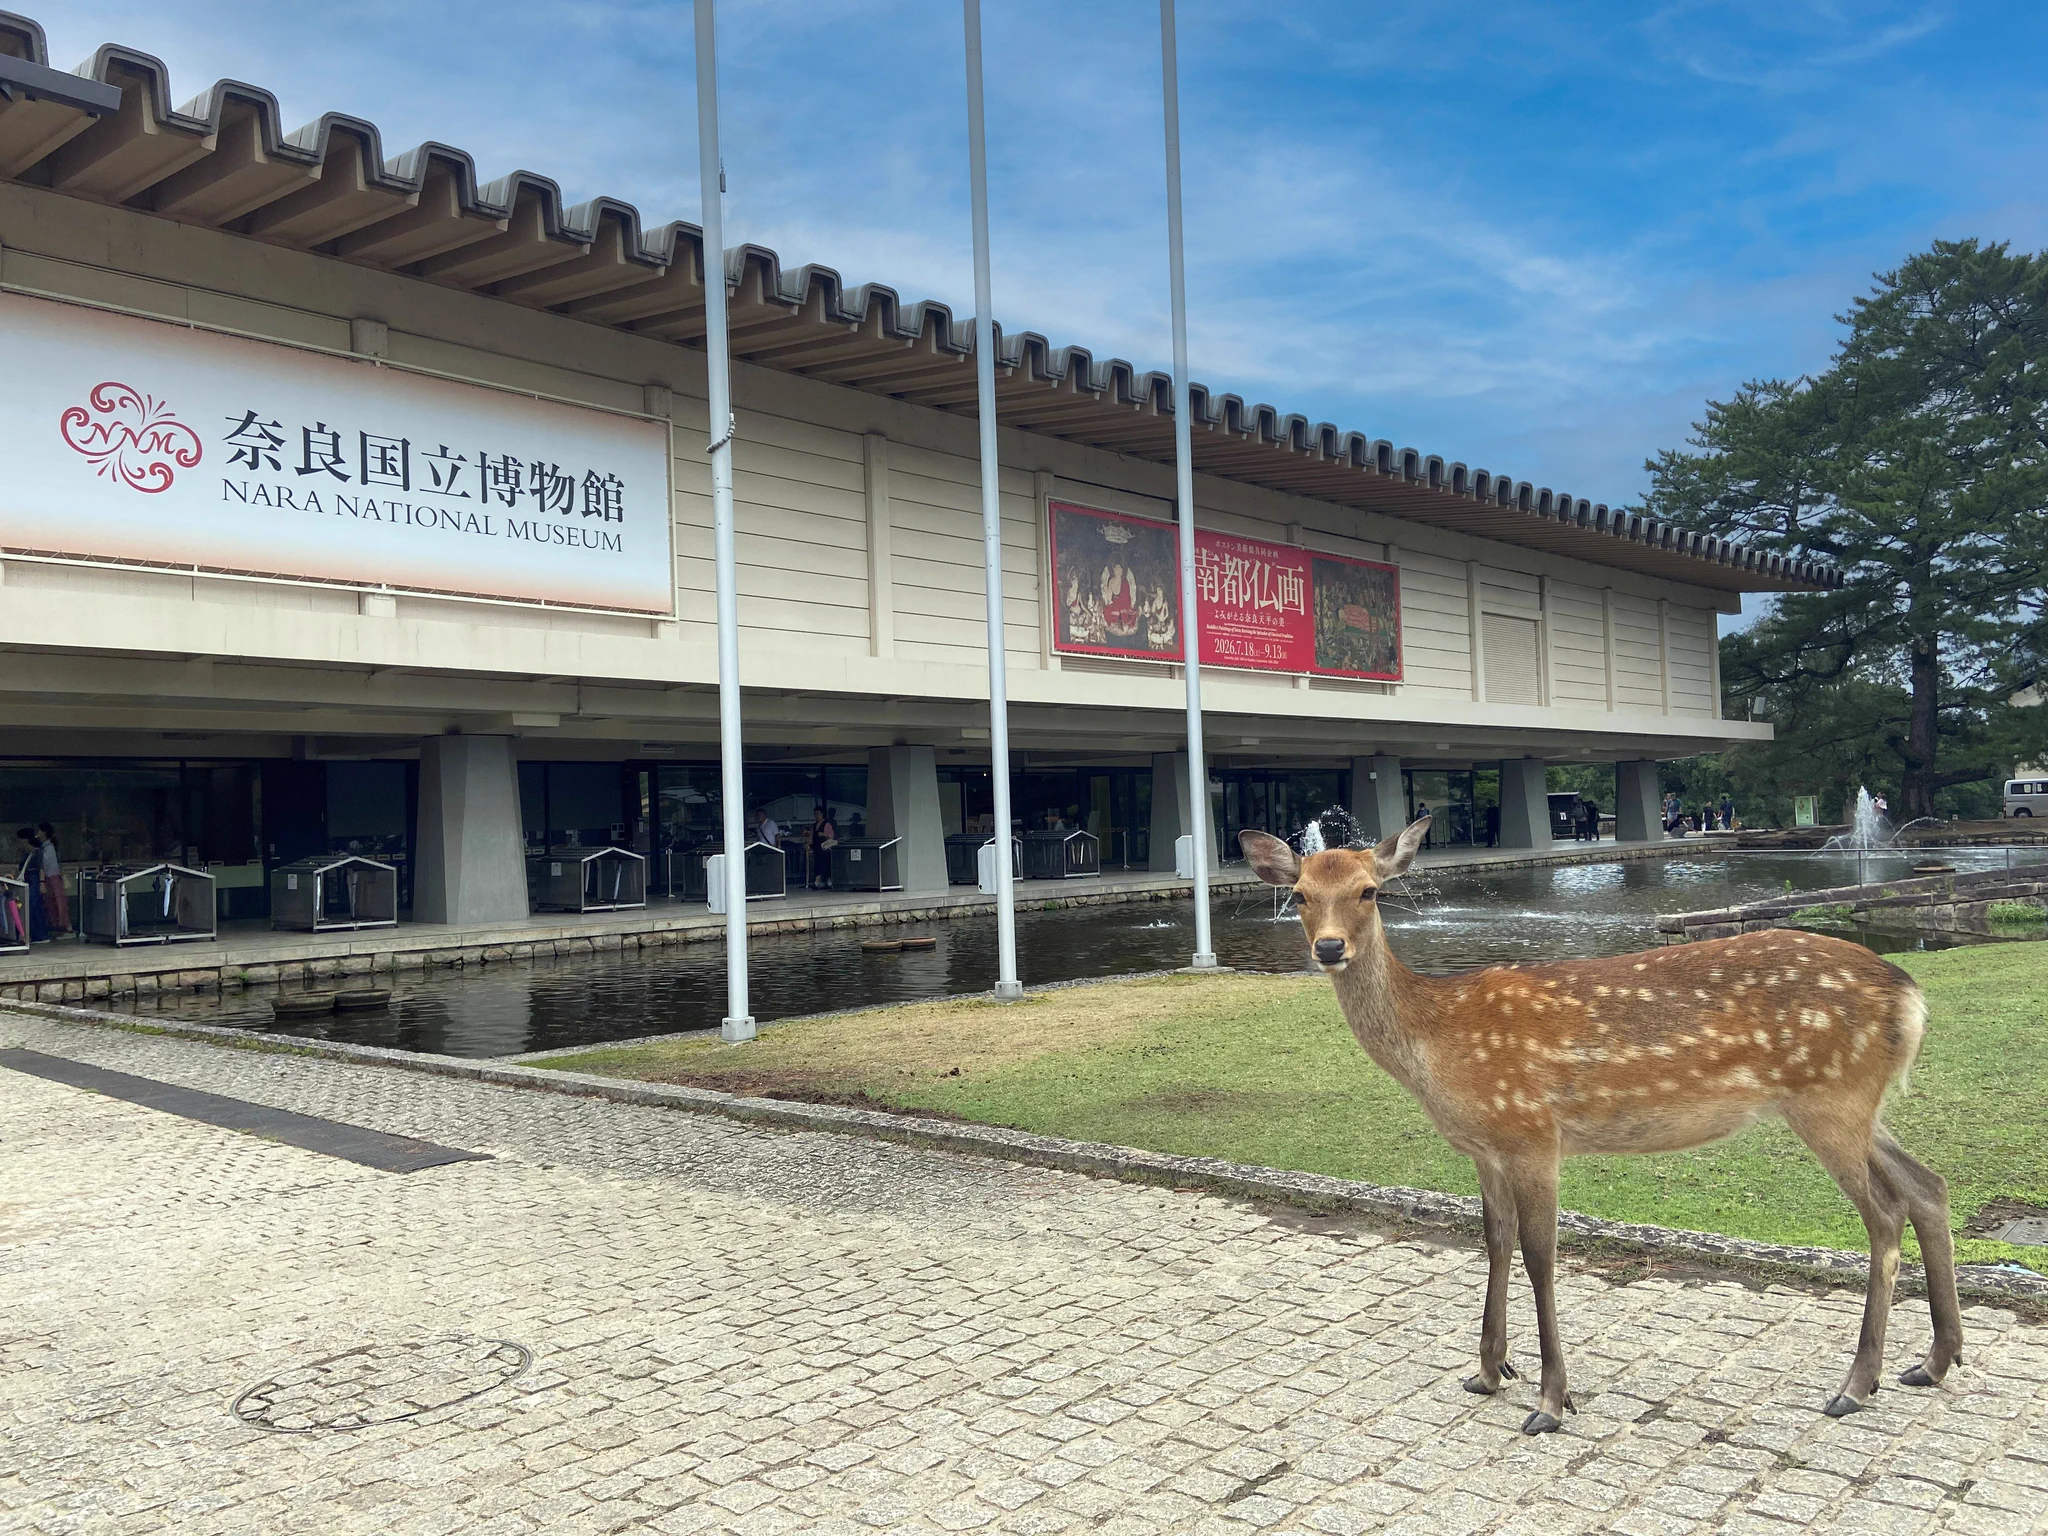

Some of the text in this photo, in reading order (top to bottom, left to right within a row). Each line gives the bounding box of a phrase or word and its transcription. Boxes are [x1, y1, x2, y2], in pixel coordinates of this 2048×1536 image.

[222, 409, 625, 523] 奈良国立博物館
[221, 478, 623, 552] NARA NATIONAL MUSEUM
[1194, 547, 1304, 616] 南都仏画
